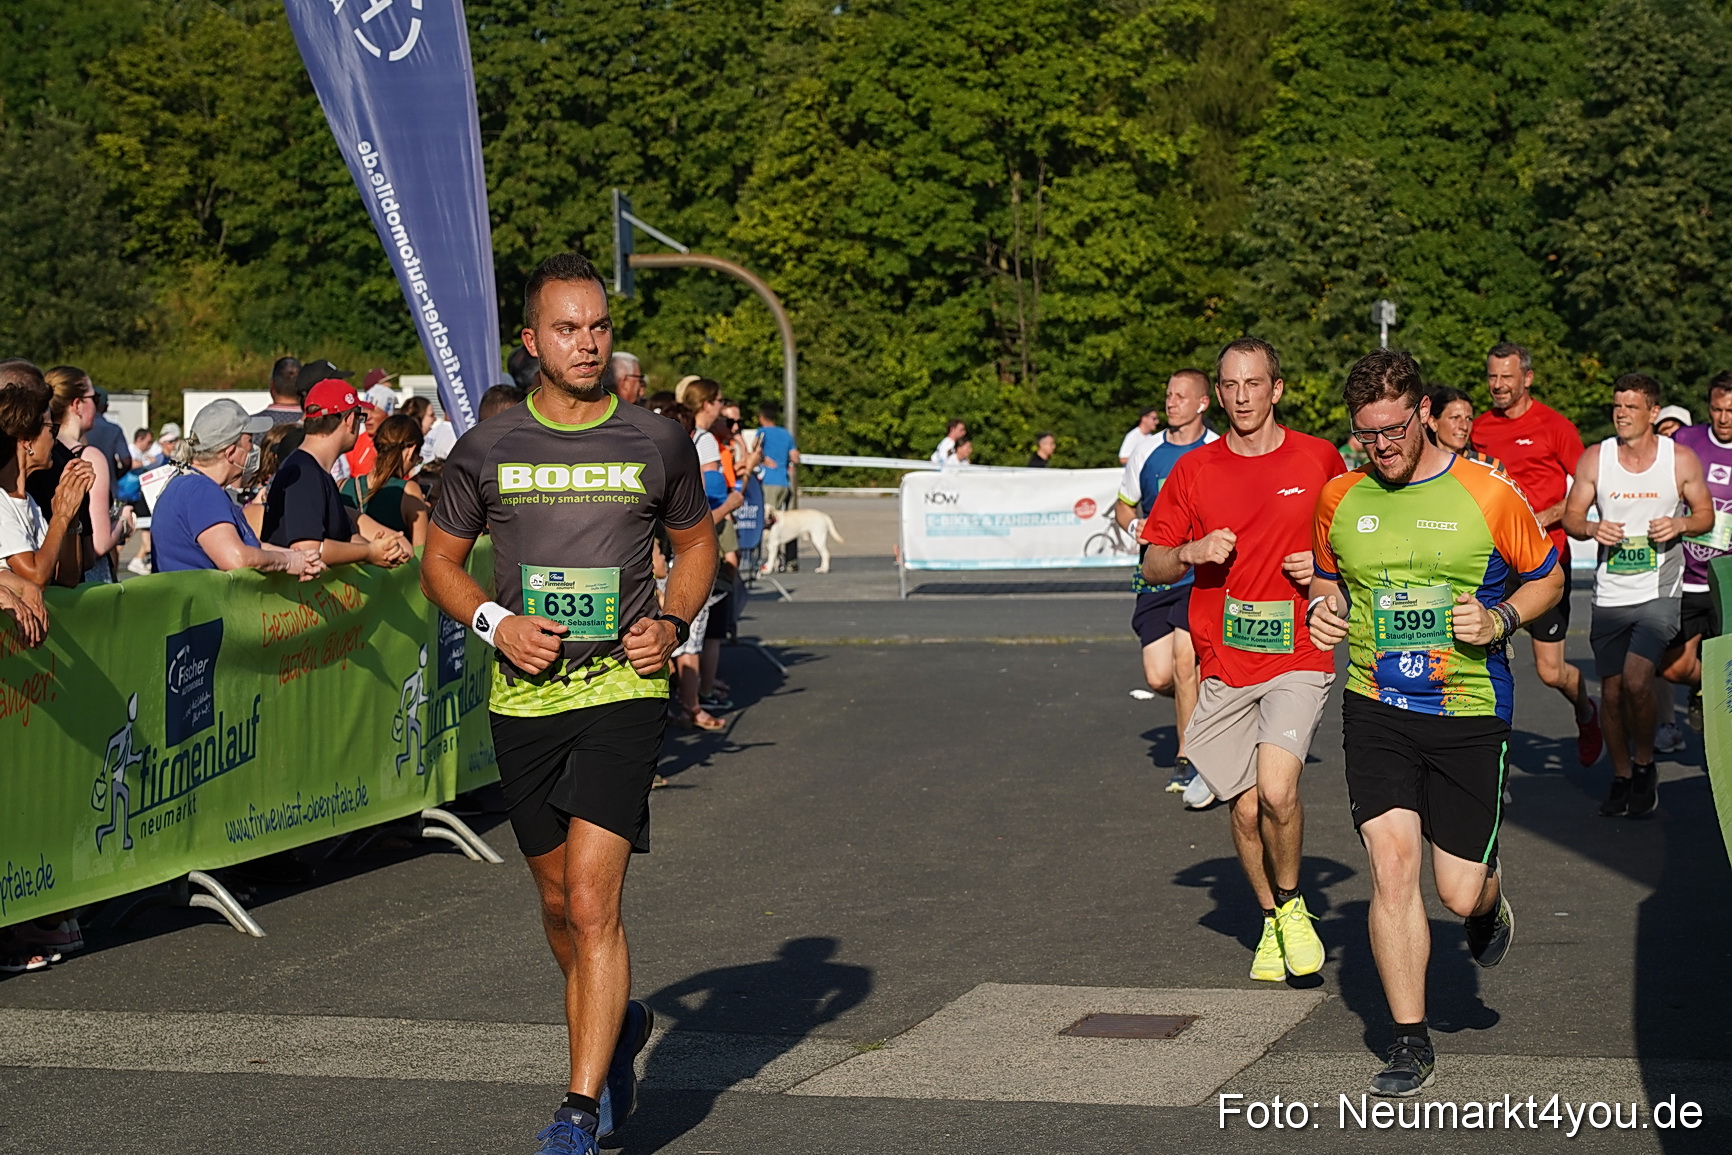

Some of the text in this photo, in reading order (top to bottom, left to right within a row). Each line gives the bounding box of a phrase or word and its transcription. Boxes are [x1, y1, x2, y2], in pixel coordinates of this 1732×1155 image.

[499, 464, 645, 492] BOCK
[500, 494, 640, 506] inspired by smart concepts
[924, 492, 959, 504] NOW
[1416, 519, 1458, 531] BOCK
[1618, 549, 1645, 561] 406
[528, 598, 536, 614] UN
[544, 593, 594, 617] 633
[605, 597, 615, 630] 2022
[1234, 617, 1281, 636] 1729
[1378, 617, 1386, 639] RUN
[1393, 609, 1435, 631] 599
[1445, 610, 1453, 638] 2022
[1232, 633, 1249, 641] Winter
[1386, 630, 1446, 641] Staudigl Dominik
[178, 658, 209, 687] Fischer
[140, 694, 261, 812] firmenlauf
[140, 793, 197, 839] neumarkt
[225, 776, 369, 844] www.firmenlauf-oberpfalz.de
